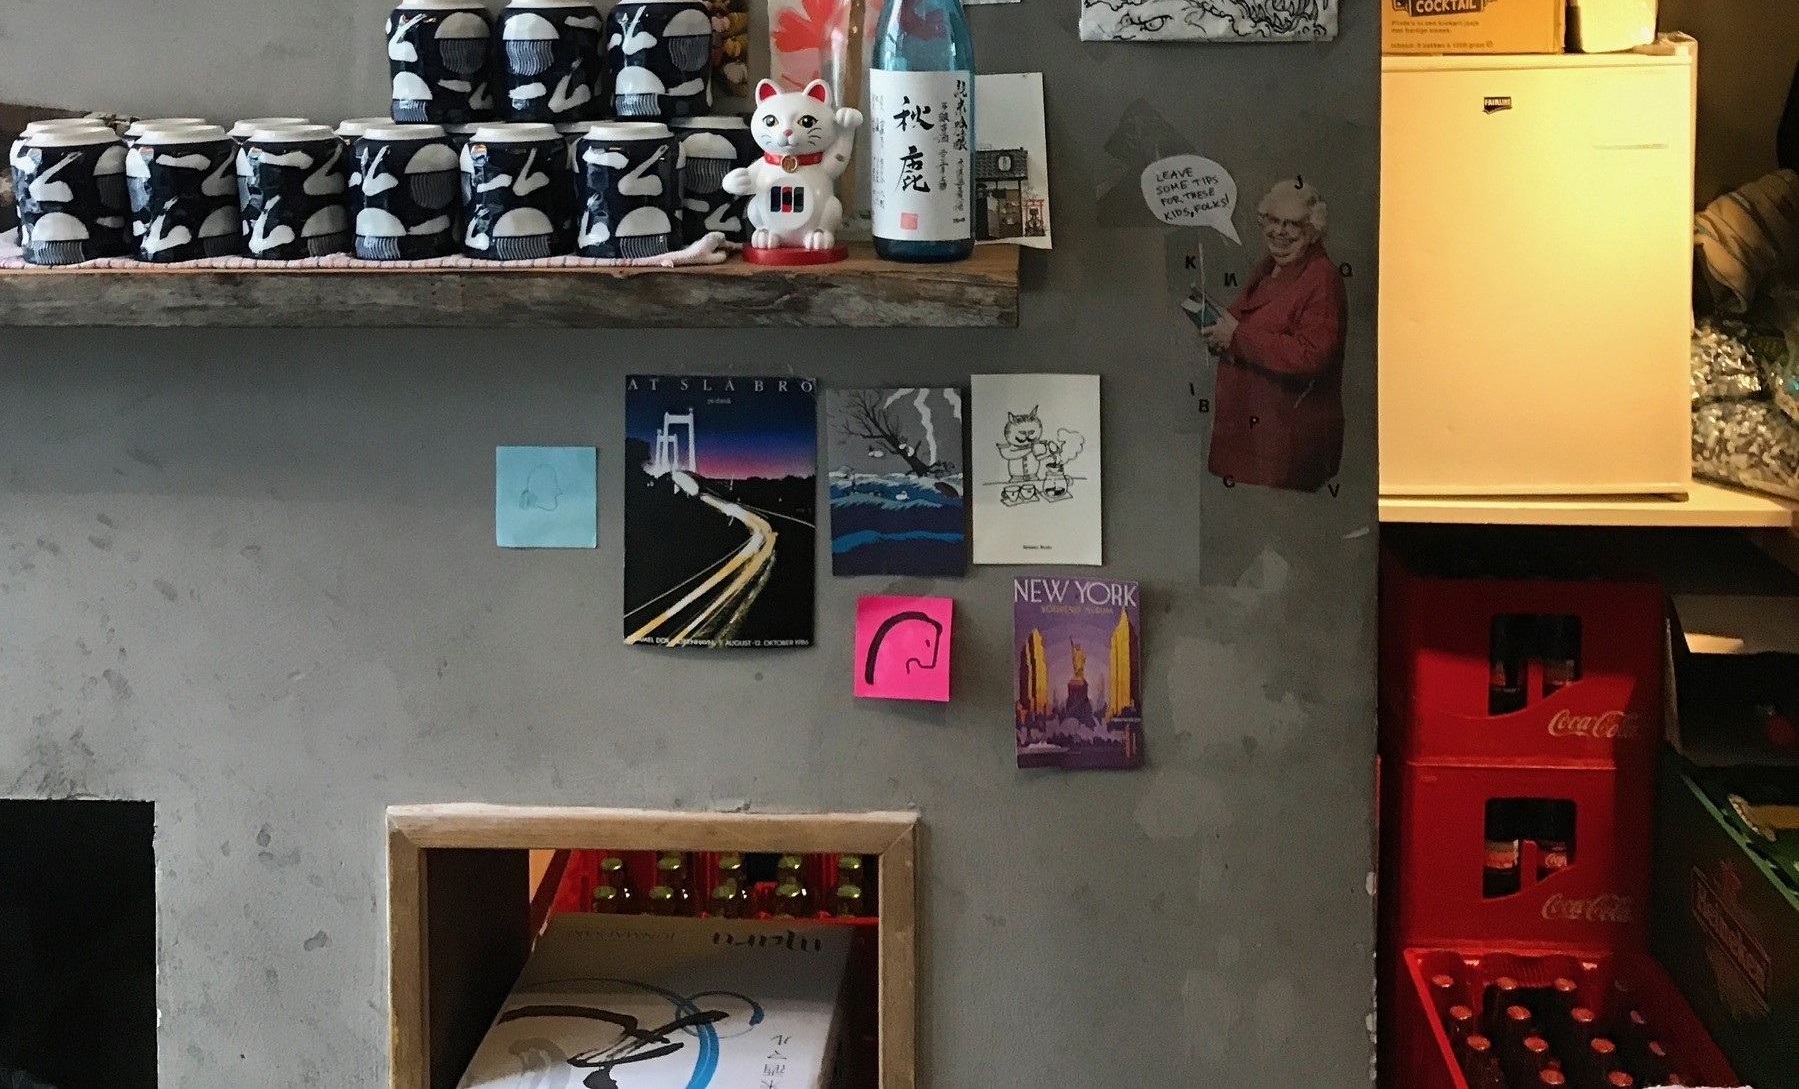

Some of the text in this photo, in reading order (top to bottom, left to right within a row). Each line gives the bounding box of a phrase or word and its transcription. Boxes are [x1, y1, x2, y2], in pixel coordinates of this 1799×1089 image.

[893, 95, 935, 193] 秋鹿
[1156, 167, 1193, 182] LEAVE
[1156, 176, 1218, 195] SOME TIPS
[1161, 188, 1215, 207] FOR THESE
[1185, 255, 1197, 270] K
[628, 379, 659, 391] AT
[754, 380, 813, 393] BRO
[1198, 399, 1210, 413] B
[1327, 483, 1340, 498] V
[1014, 578, 1137, 607] NEW YORK
